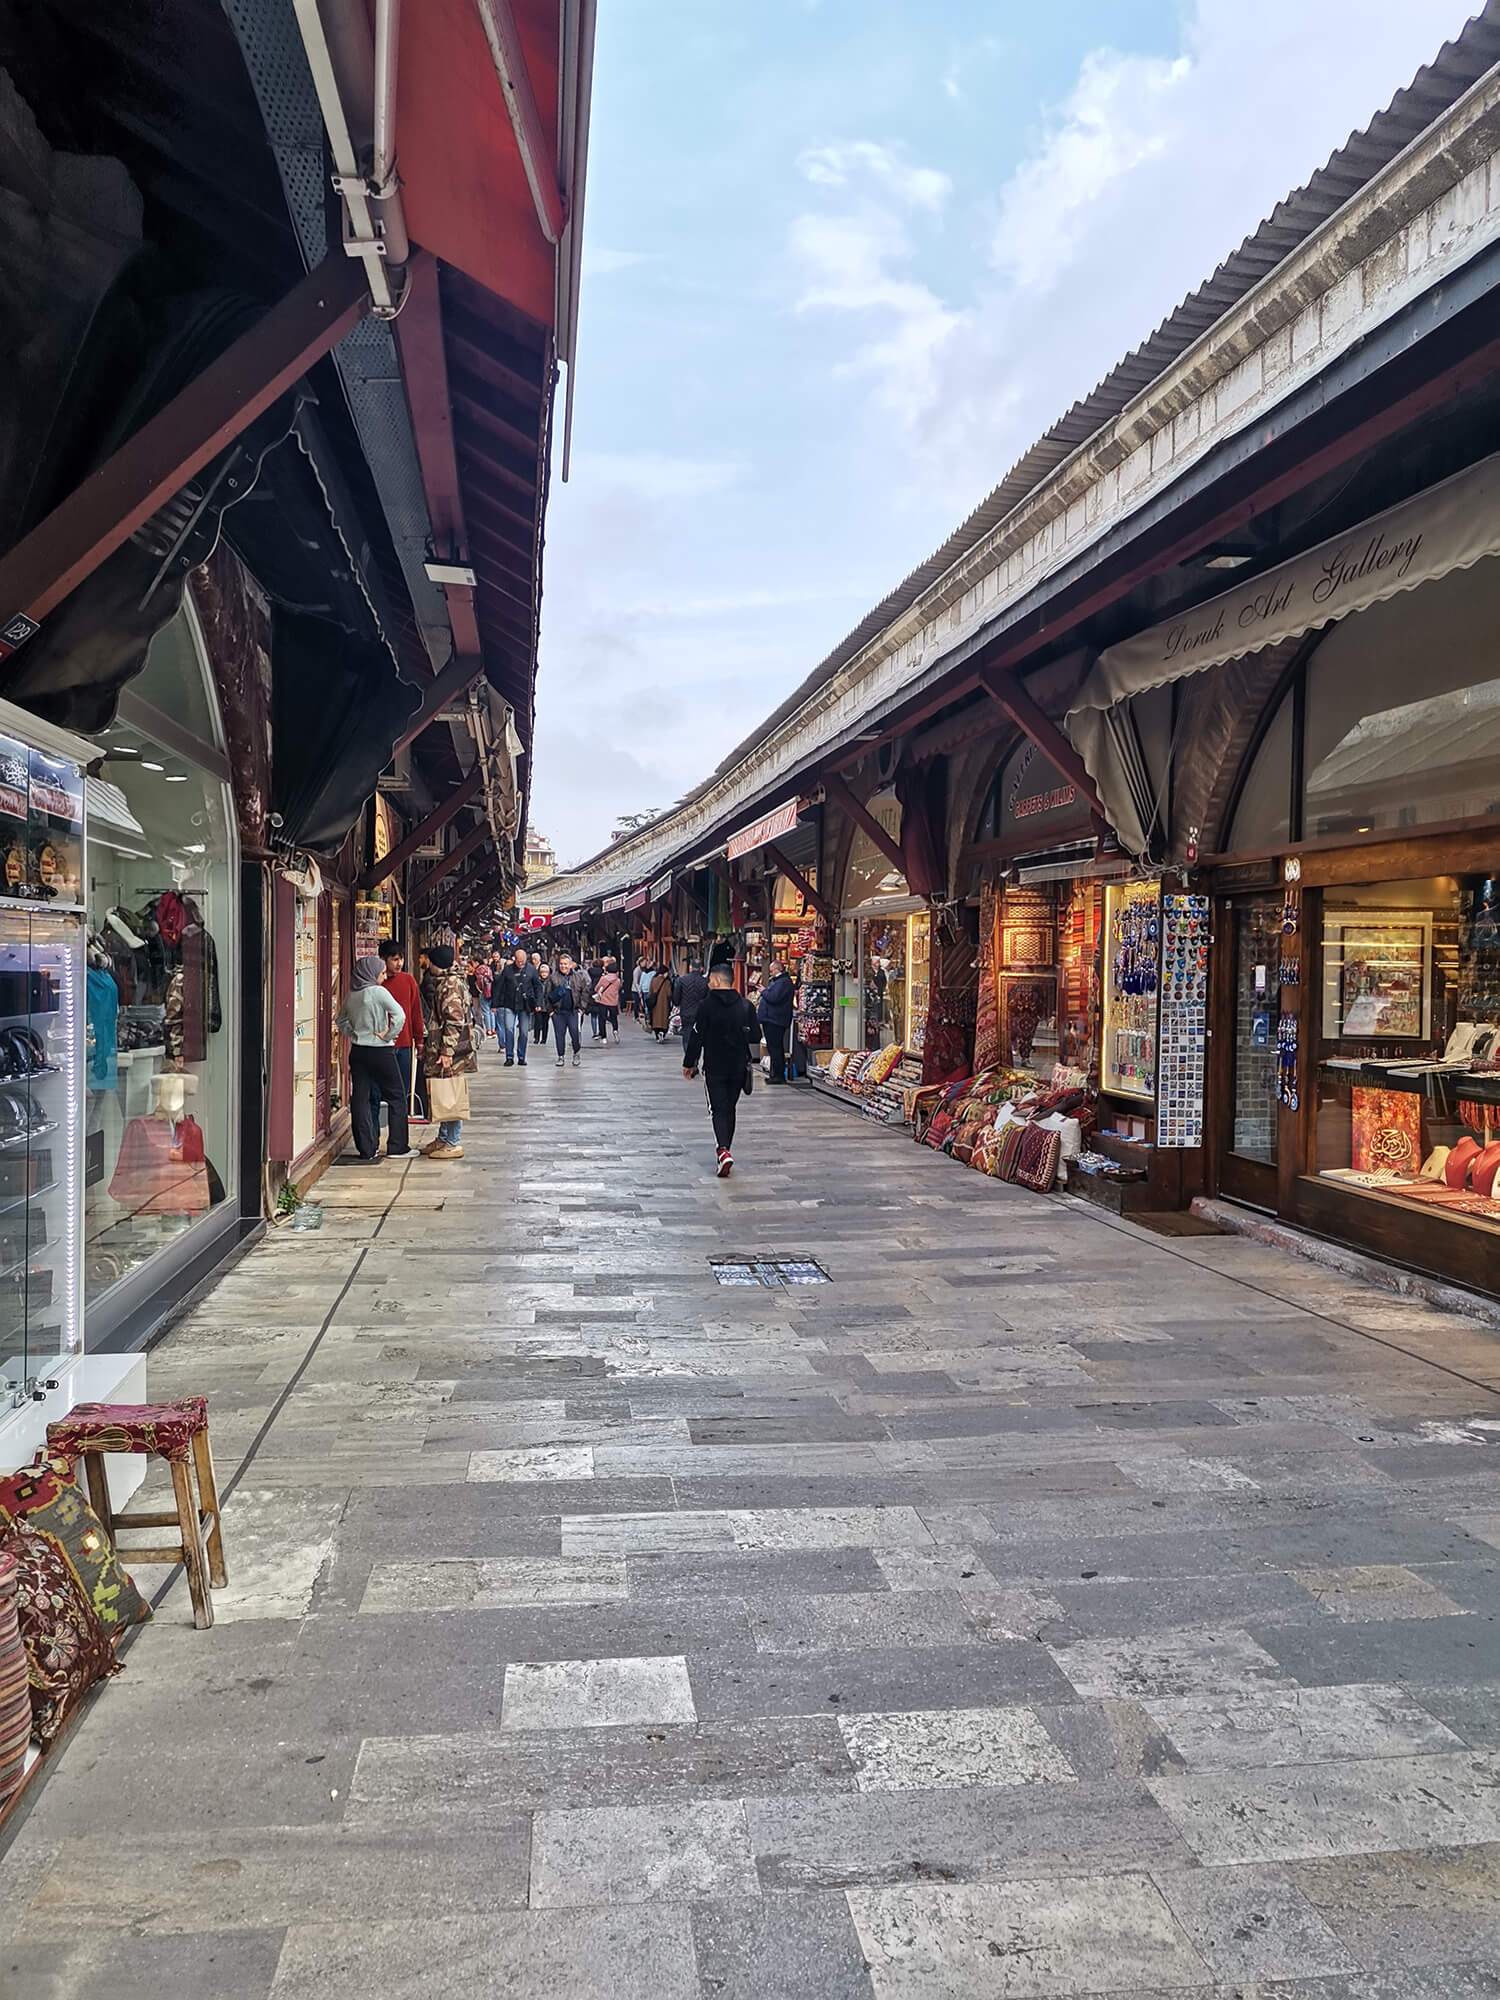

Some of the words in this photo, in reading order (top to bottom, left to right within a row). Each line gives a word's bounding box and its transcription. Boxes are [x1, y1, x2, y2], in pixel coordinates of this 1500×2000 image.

[4, 622, 31, 641] 129
[1163, 609, 1224, 661] Doruk
[1238, 581, 1295, 629] Art
[1312, 534, 1424, 604] Gallery
